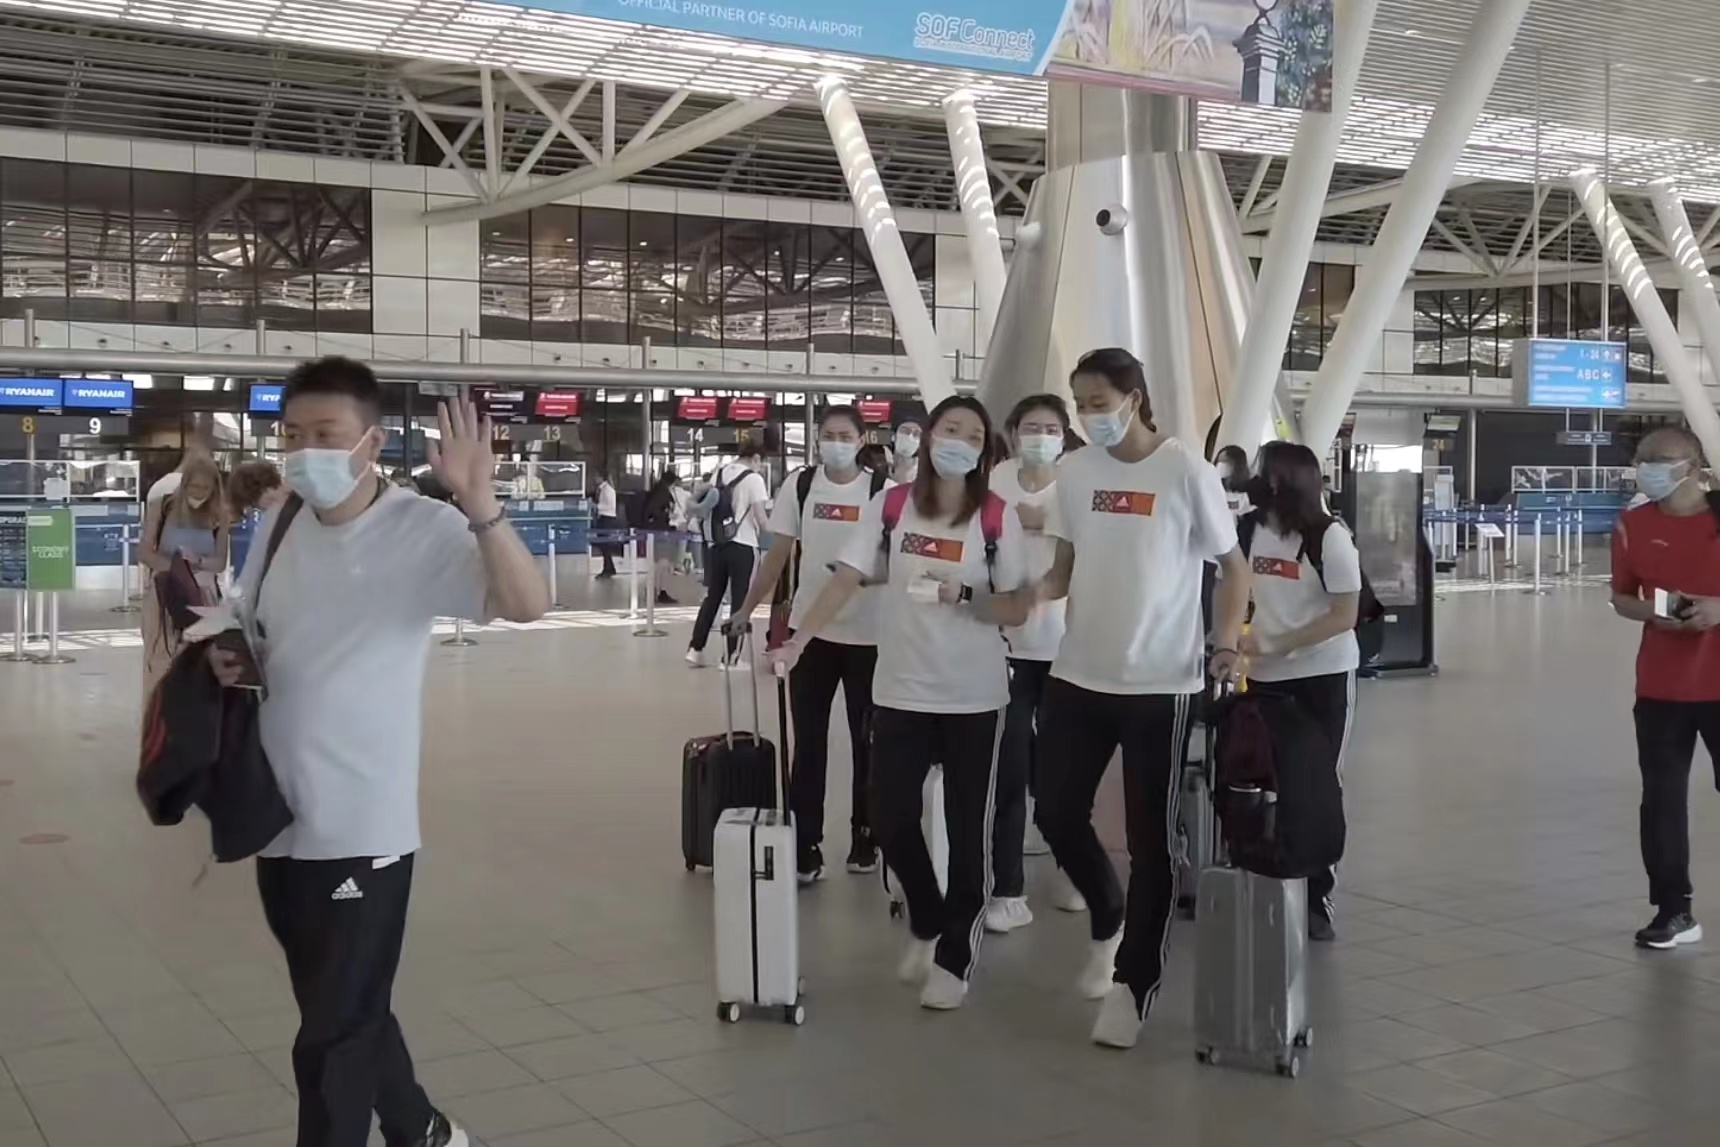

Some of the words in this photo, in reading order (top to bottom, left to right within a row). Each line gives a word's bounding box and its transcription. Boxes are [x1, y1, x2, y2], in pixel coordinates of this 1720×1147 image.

[682, 2, 745, 22] PARTNER
[747, 10, 766, 24] OF
[768, 13, 807, 31] SOFIA
[808, 19, 864, 38] AIRPORT
[5, 387, 55, 397] RYANAIR
[78, 388, 126, 399] RYANAIR
[22, 416, 34, 433] 8
[89, 417, 102, 434] 9
[493, 425, 510, 440] 12
[543, 425, 561, 440] 13
[686, 427, 704, 442] 14
